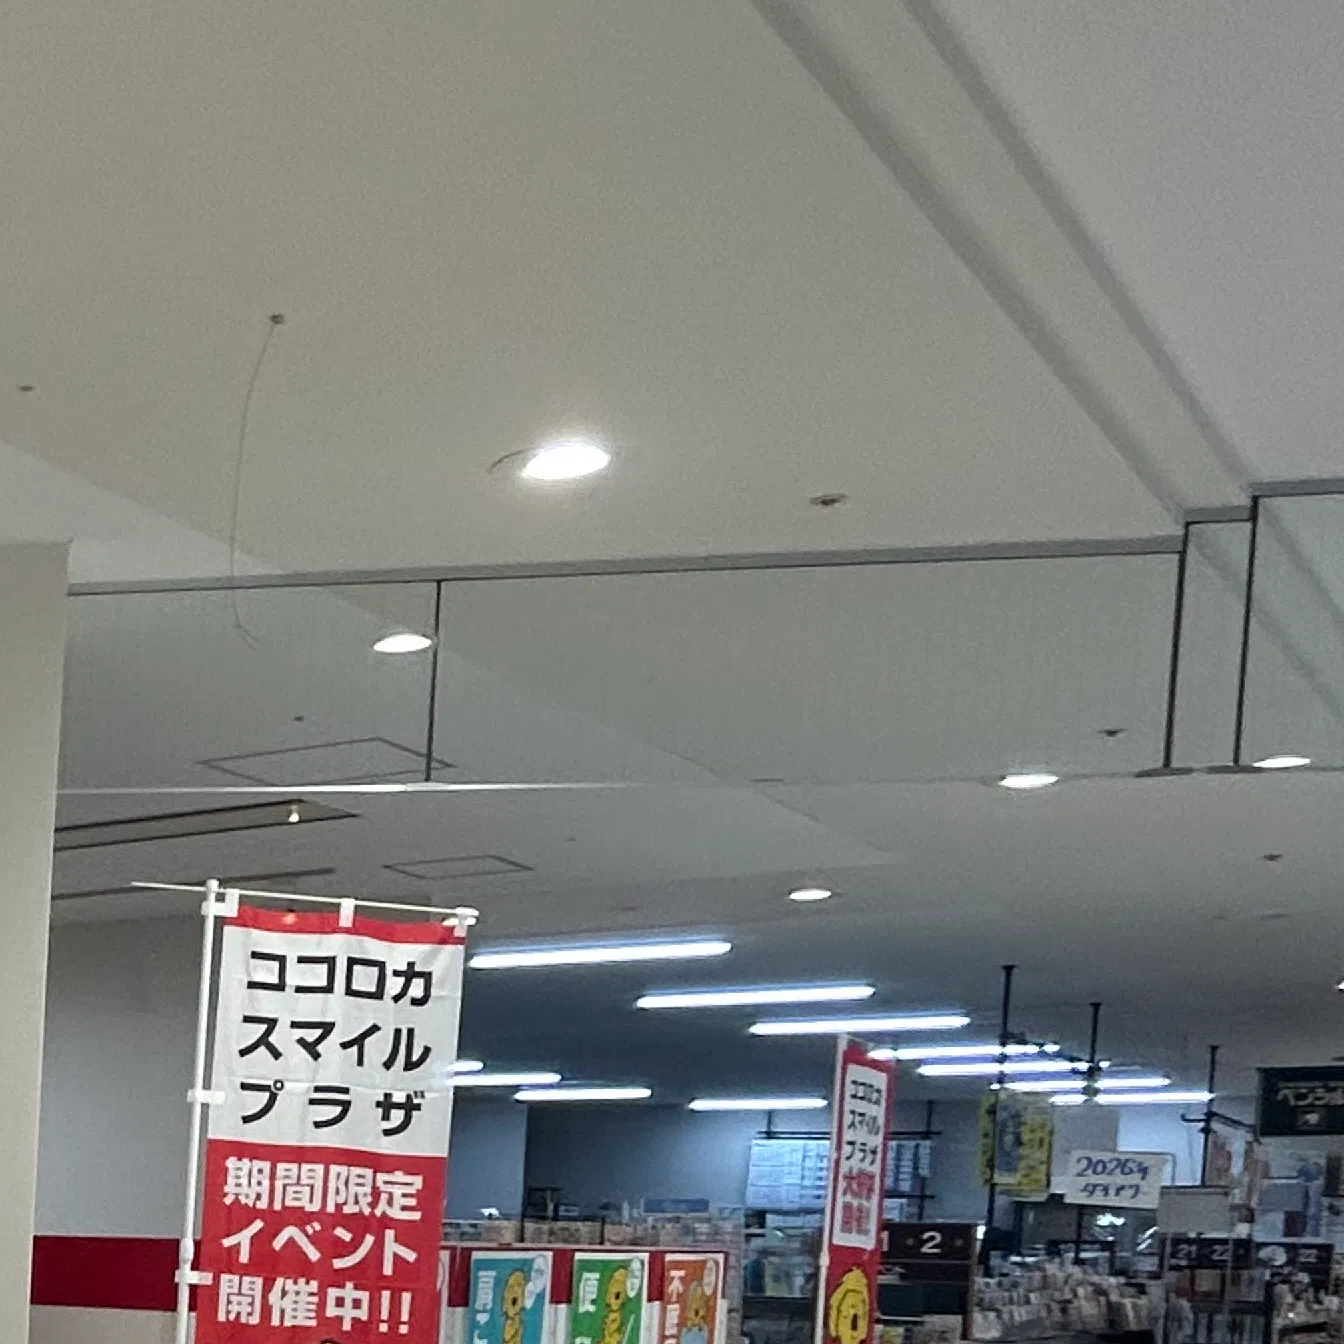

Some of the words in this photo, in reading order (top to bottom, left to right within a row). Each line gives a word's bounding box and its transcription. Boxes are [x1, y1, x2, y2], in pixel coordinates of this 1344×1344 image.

[246, 950, 432, 1007] ココロカ
[238, 1015, 432, 1072] スマイル
[240, 1079, 425, 1137] プラザ
[223, 1156, 423, 1221] 期間限定
[220, 1219, 418, 1276] イベント
[920, 1230, 942, 1254] 2
[216, 1272, 411, 1335] 開催中!!
